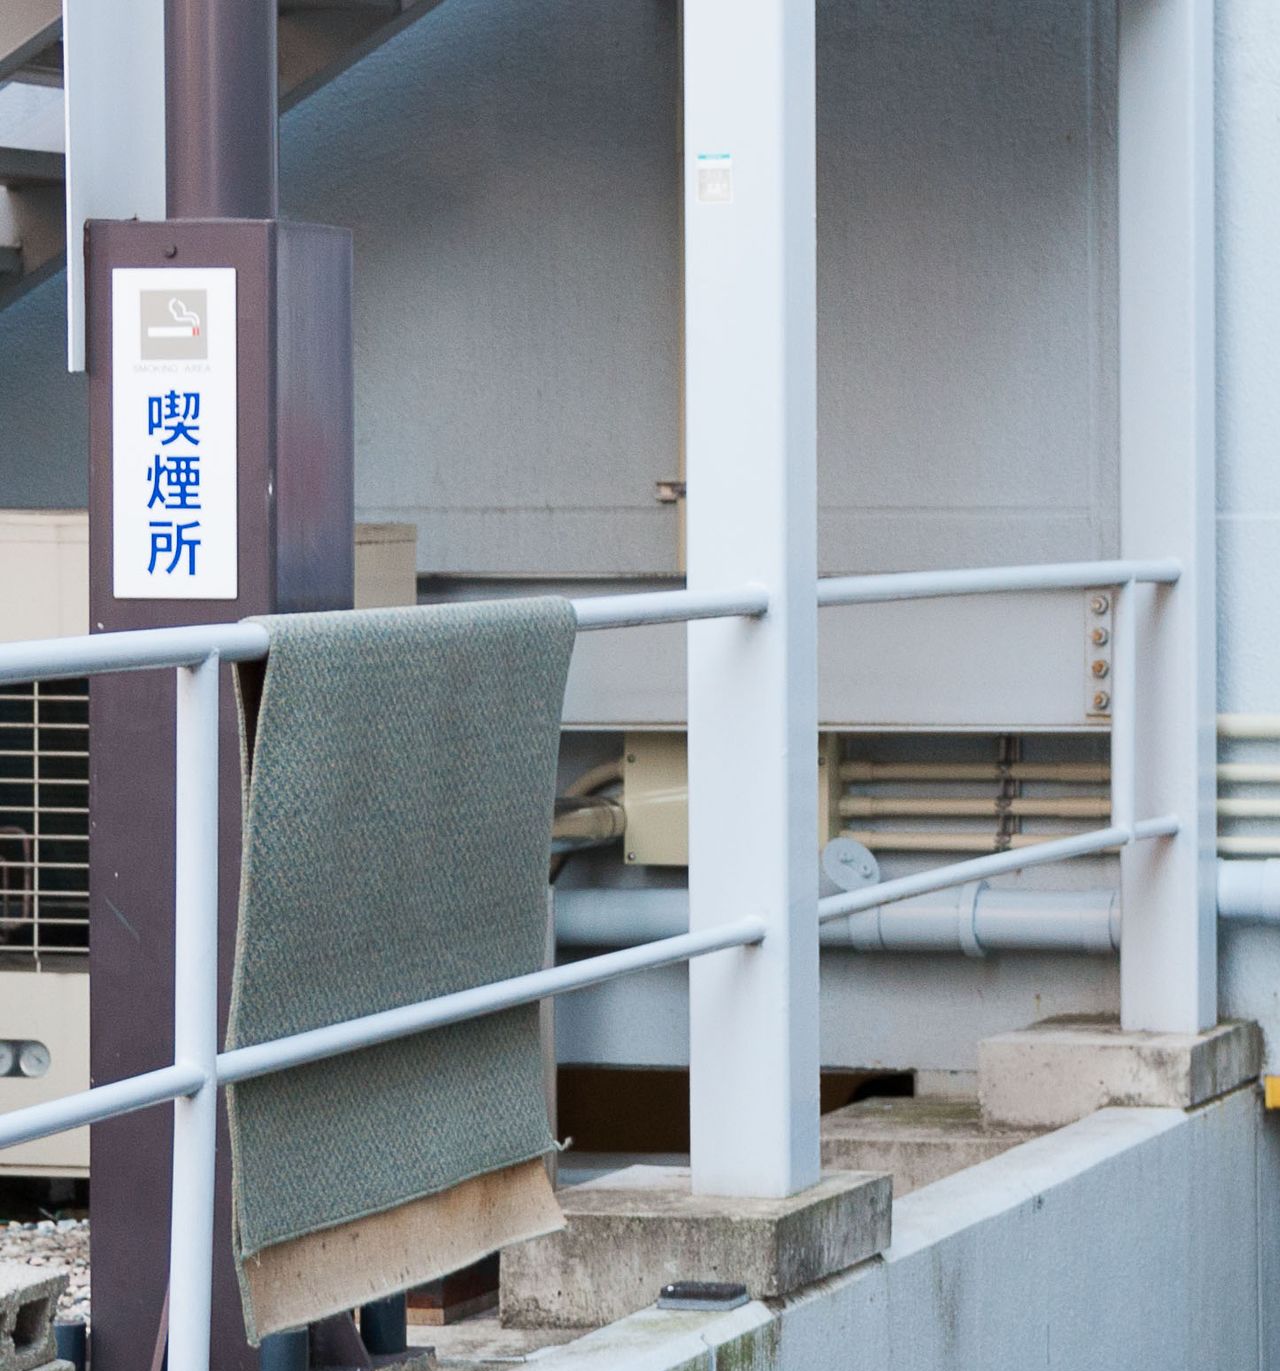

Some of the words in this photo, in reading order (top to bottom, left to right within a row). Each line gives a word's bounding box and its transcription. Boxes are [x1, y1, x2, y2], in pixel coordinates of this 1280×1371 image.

[133, 363, 178, 374] SMOKING
[183, 363, 212, 374] AREA
[147, 390, 202, 576] 喫煙所
